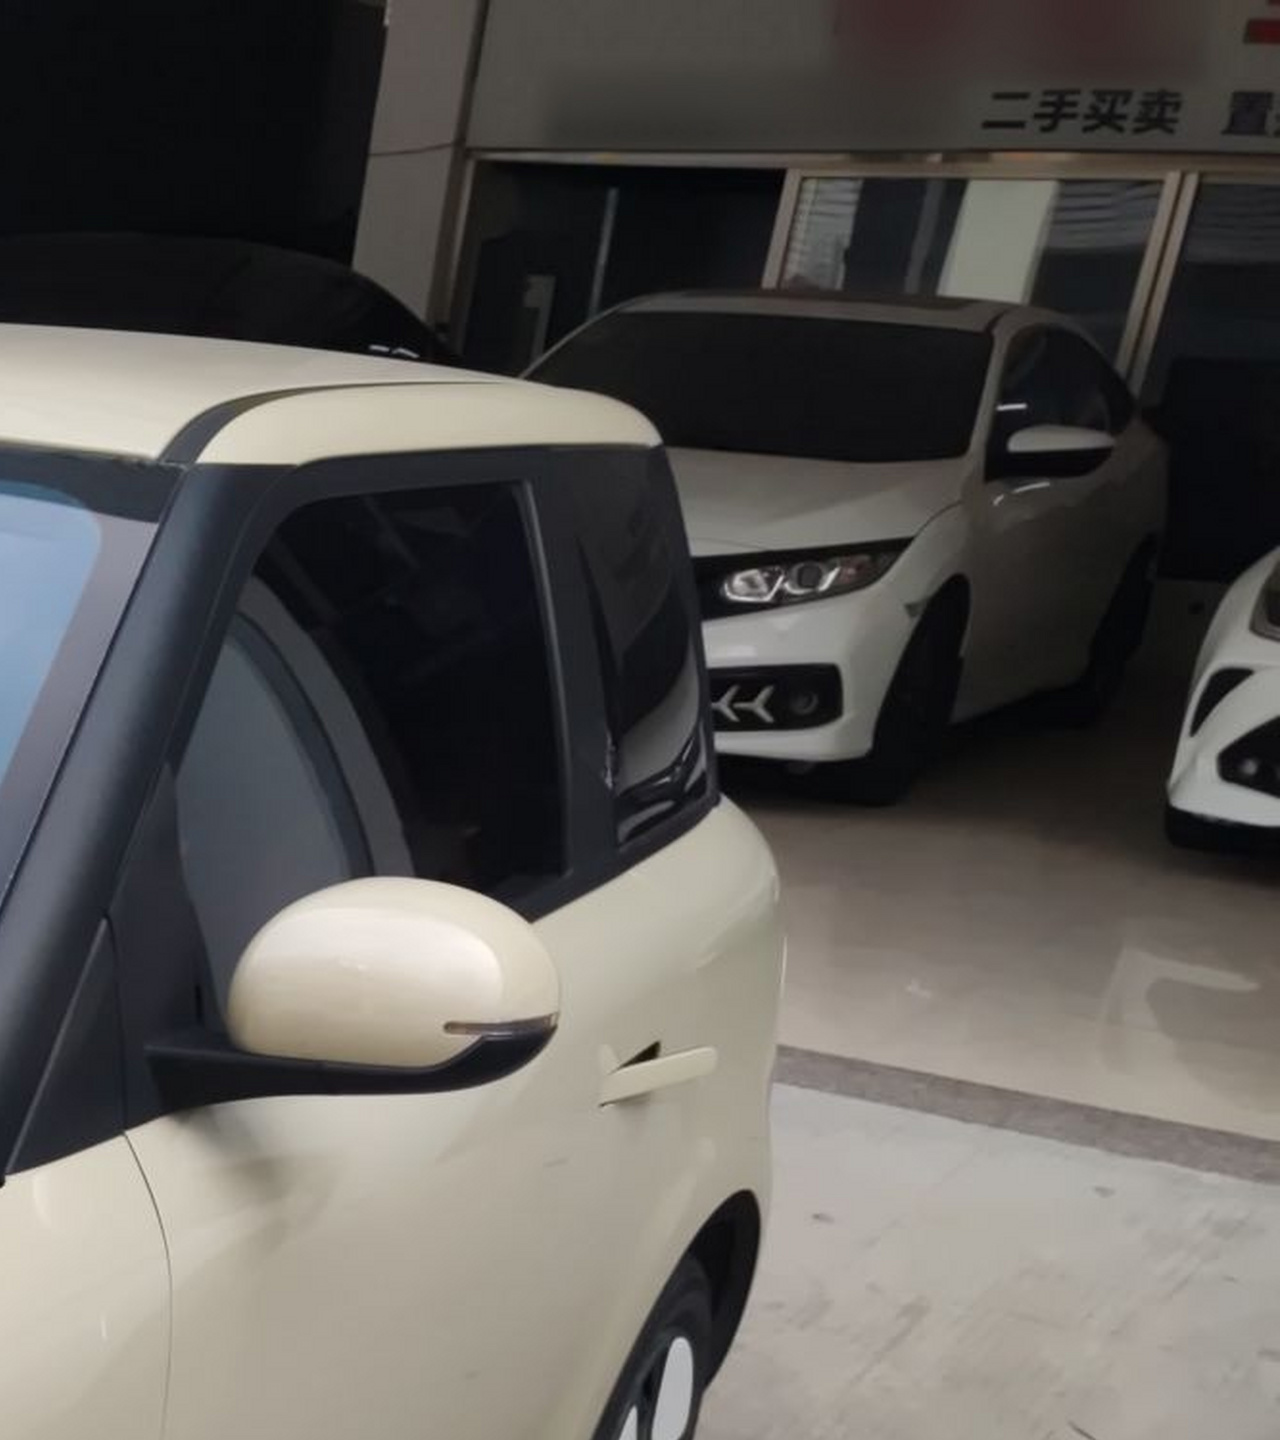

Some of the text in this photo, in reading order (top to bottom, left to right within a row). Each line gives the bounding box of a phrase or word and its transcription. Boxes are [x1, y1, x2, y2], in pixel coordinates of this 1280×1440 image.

[981, 88, 1280, 137] 二手买卖 置
